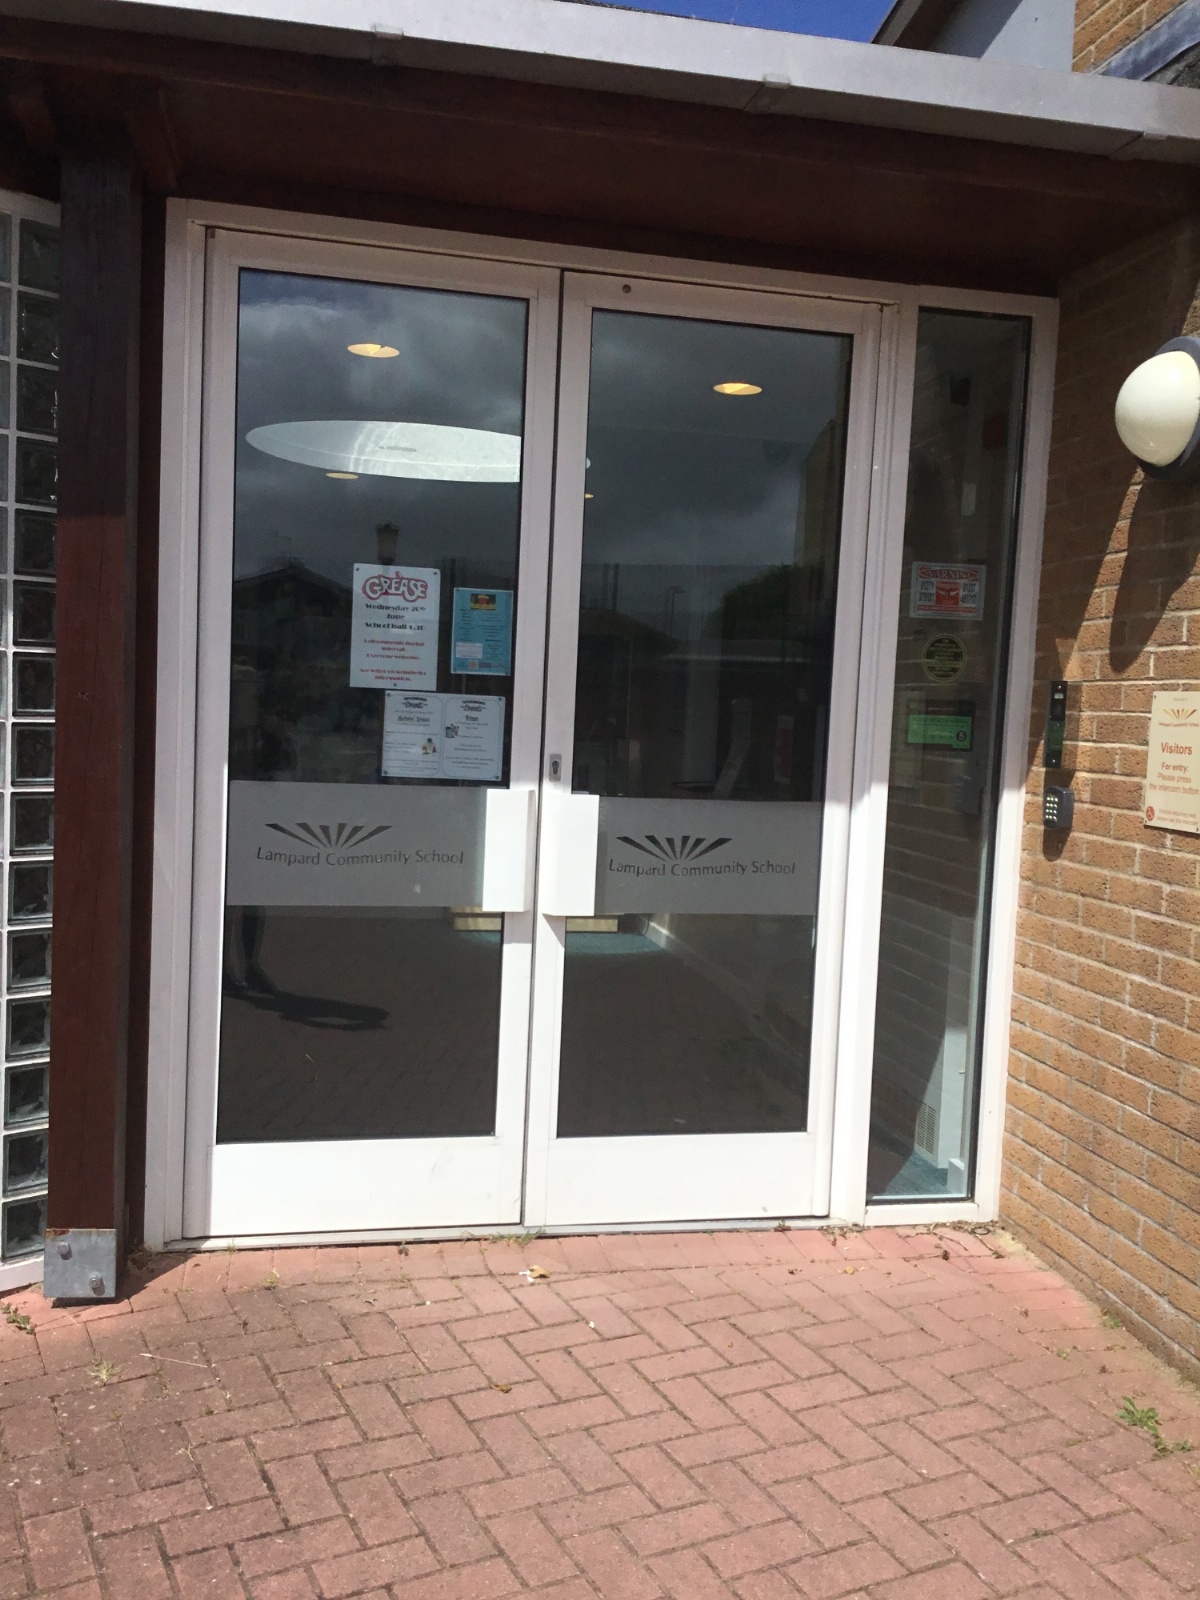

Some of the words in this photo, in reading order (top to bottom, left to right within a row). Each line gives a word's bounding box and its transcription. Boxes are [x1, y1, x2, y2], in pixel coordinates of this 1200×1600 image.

[363, 575, 428, 602] GREASE
[365, 603, 410, 612] Wednesday
[1161, 742, 1193, 755] Visitors
[1161, 762, 1171, 770] For
[1172, 764, 1189, 774] entry:
[1157, 772, 1176, 782] Please
[1177, 776, 1192, 784] press
[1158, 785, 1181, 793] intercom
[1182, 786, 1199, 795] button
[256, 846, 320, 867] Lampard
[326, 850, 410, 867] Community
[415, 850, 464, 864] School
[608, 859, 666, 877] Lampard
[670, 860, 747, 877] Community
[751, 860, 796, 875] School
